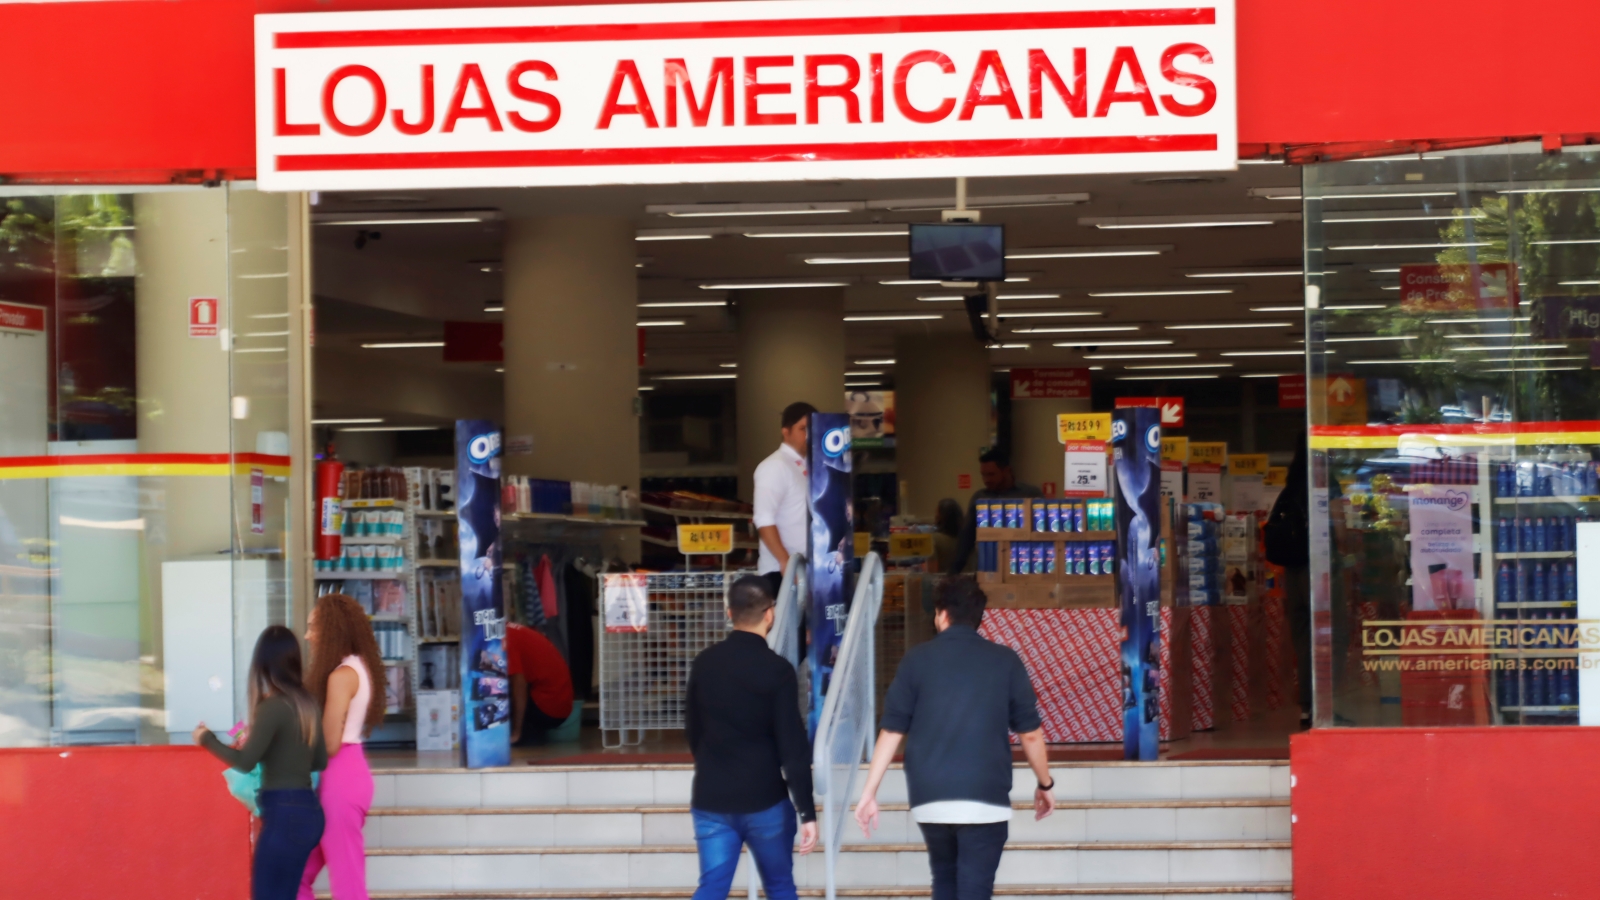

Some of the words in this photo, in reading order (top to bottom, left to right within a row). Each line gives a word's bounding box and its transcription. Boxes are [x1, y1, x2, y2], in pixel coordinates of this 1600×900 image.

[273, 60, 561, 136] LOJAS
[596, 42, 1217, 129] AMERICANAS
[1406, 289, 1423, 301] de
[1426, 289, 1465, 302] Preço
[1032, 370, 1074, 378] Terminal
[1032, 379, 1044, 387] de
[1046, 379, 1087, 387] consulta
[1032, 388, 1044, 396] de
[1412, 497, 1463, 508] monange
[1362, 629, 1437, 647] LOJAS
[1442, 627, 1600, 646] AMERICANAS
[1363, 657, 1600, 672] www.americanas.com.br
